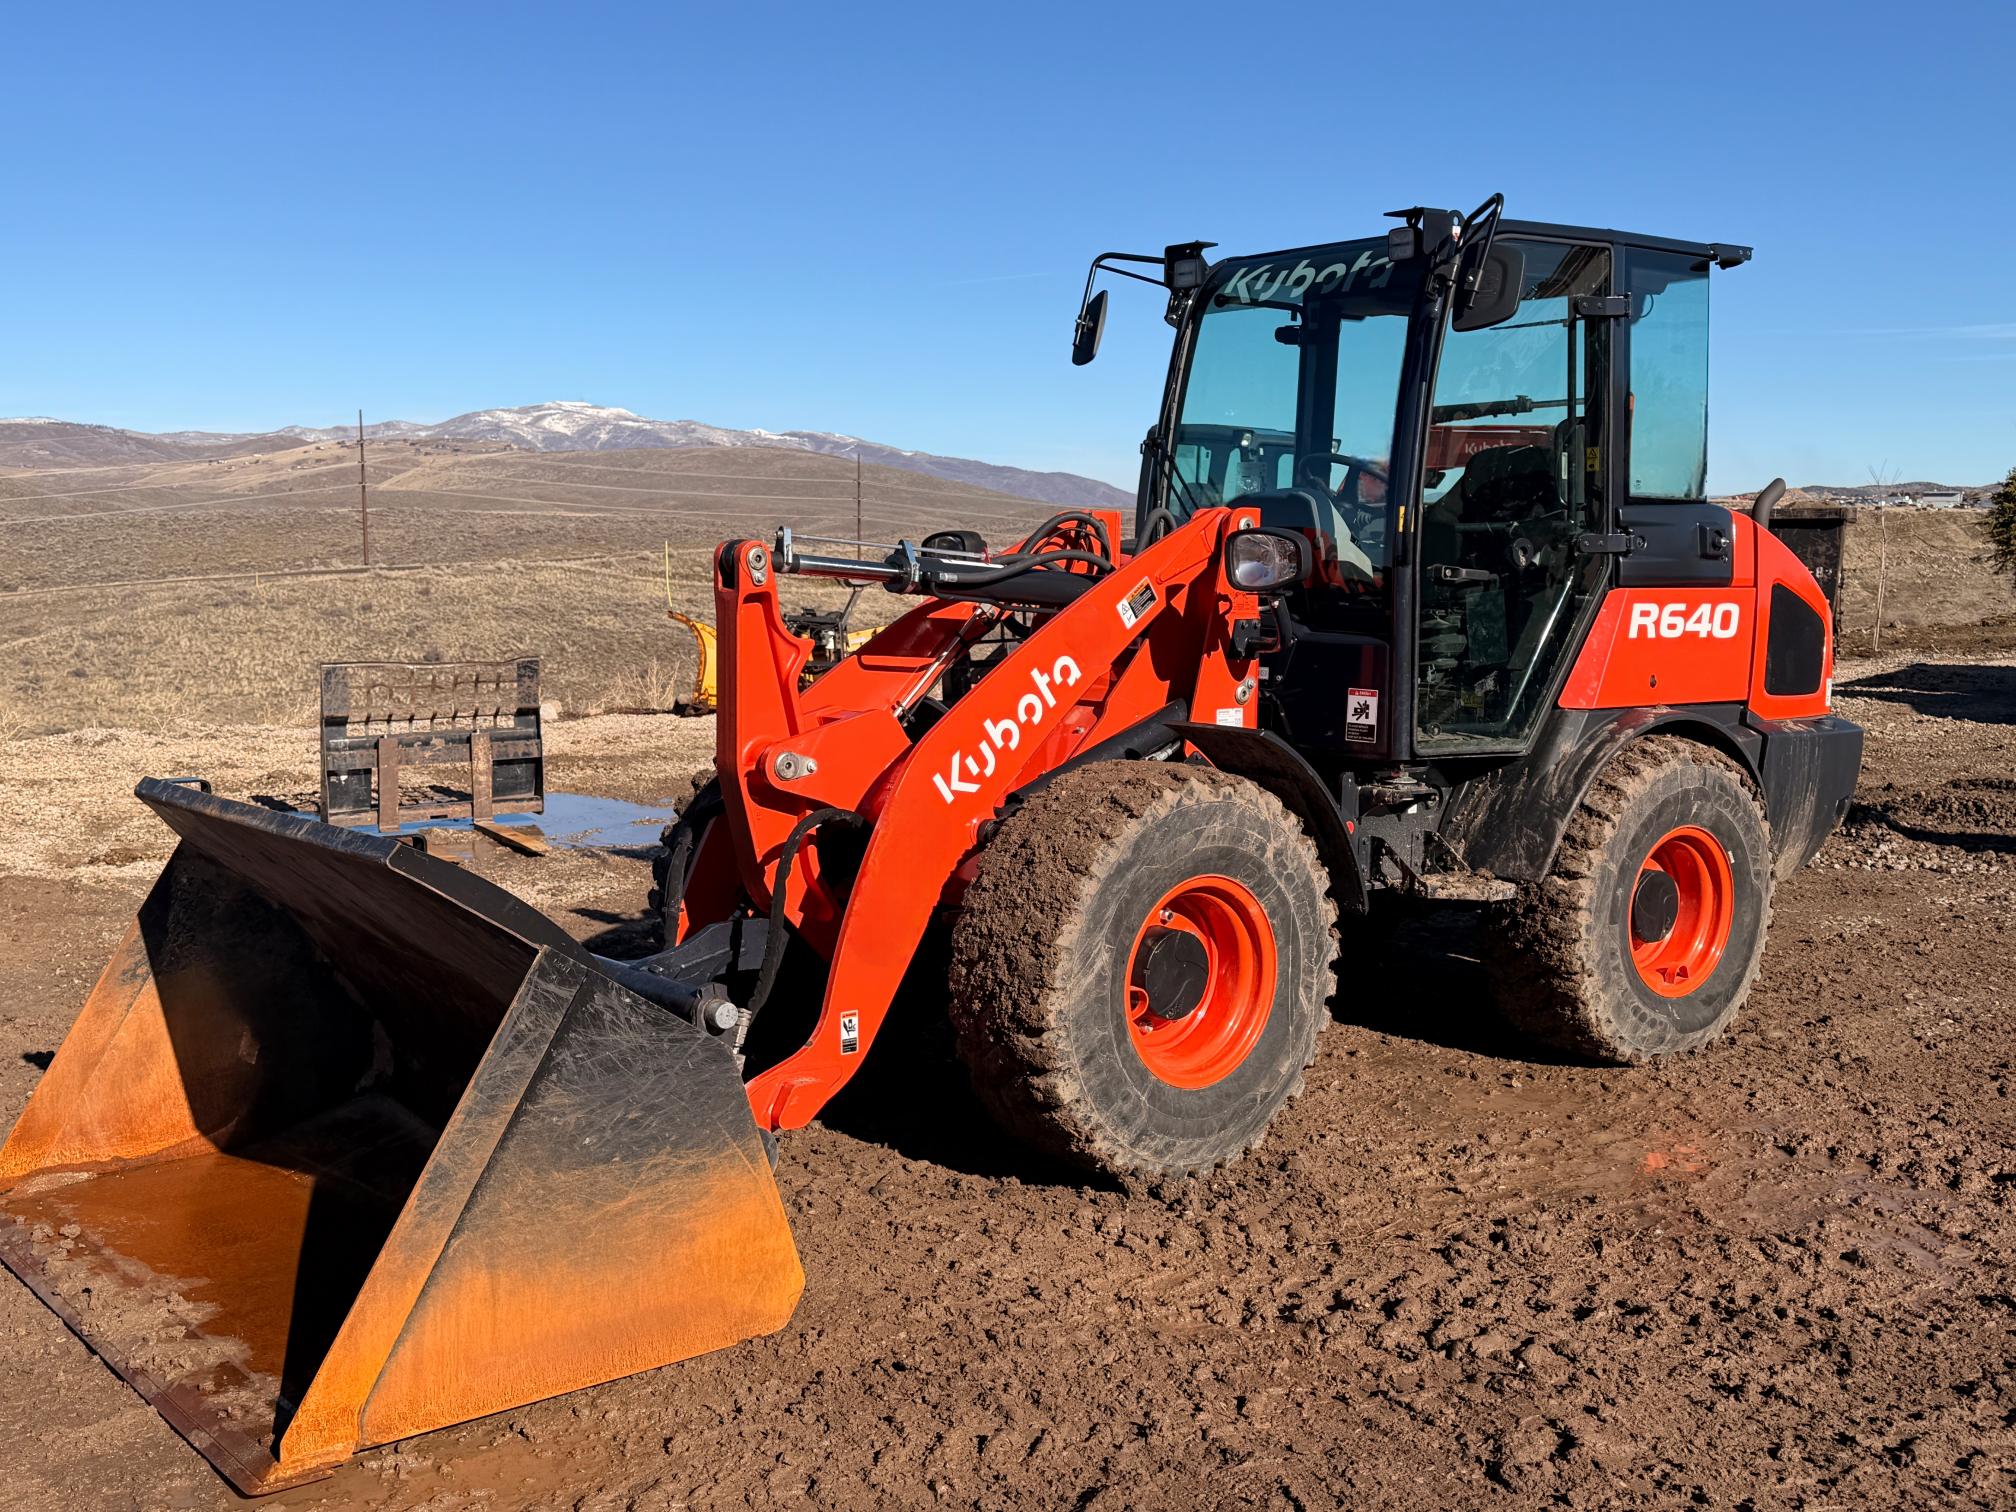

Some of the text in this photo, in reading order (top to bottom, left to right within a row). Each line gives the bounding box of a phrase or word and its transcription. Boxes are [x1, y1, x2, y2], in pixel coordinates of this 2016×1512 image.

[1224, 251, 1396, 303] Kubota
[1628, 602, 1740, 638] R640
[932, 655, 1082, 804] Kubota
